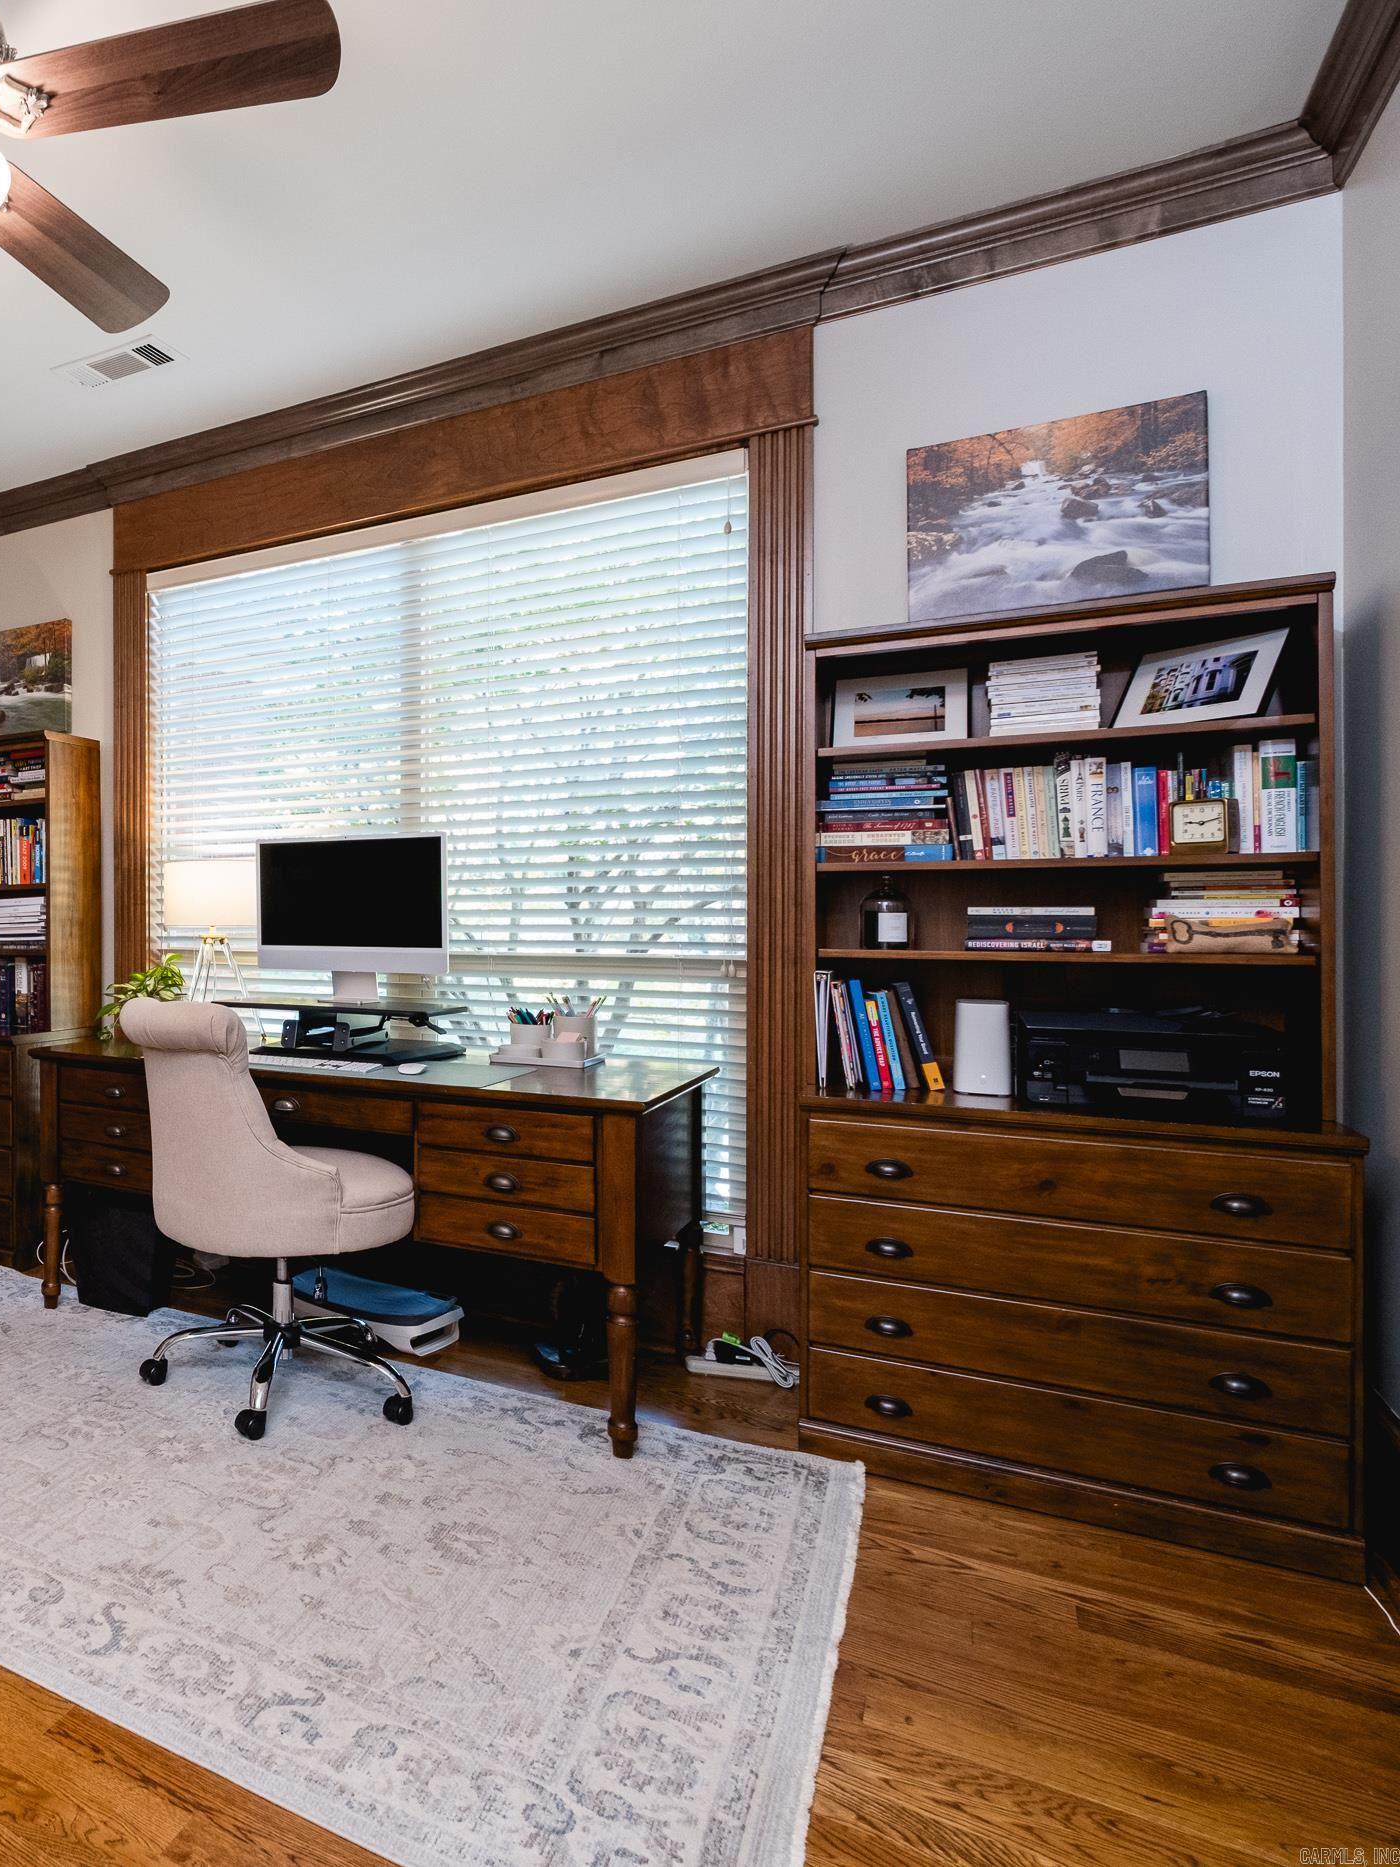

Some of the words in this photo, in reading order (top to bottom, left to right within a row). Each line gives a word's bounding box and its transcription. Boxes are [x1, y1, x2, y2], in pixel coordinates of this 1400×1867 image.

[1059, 778, 1070, 805] PARIS
[1091, 783, 1105, 833] FRANCE
[846, 847, 904, 863] grace
[967, 940, 1019, 949] REDISCOVERING
[1020, 940, 1045, 949] ISRAEL
[874, 1037, 883, 1055] ADVICE
[877, 1054, 886, 1067] TRAP
[1249, 1070, 1280, 1078] EPSON
